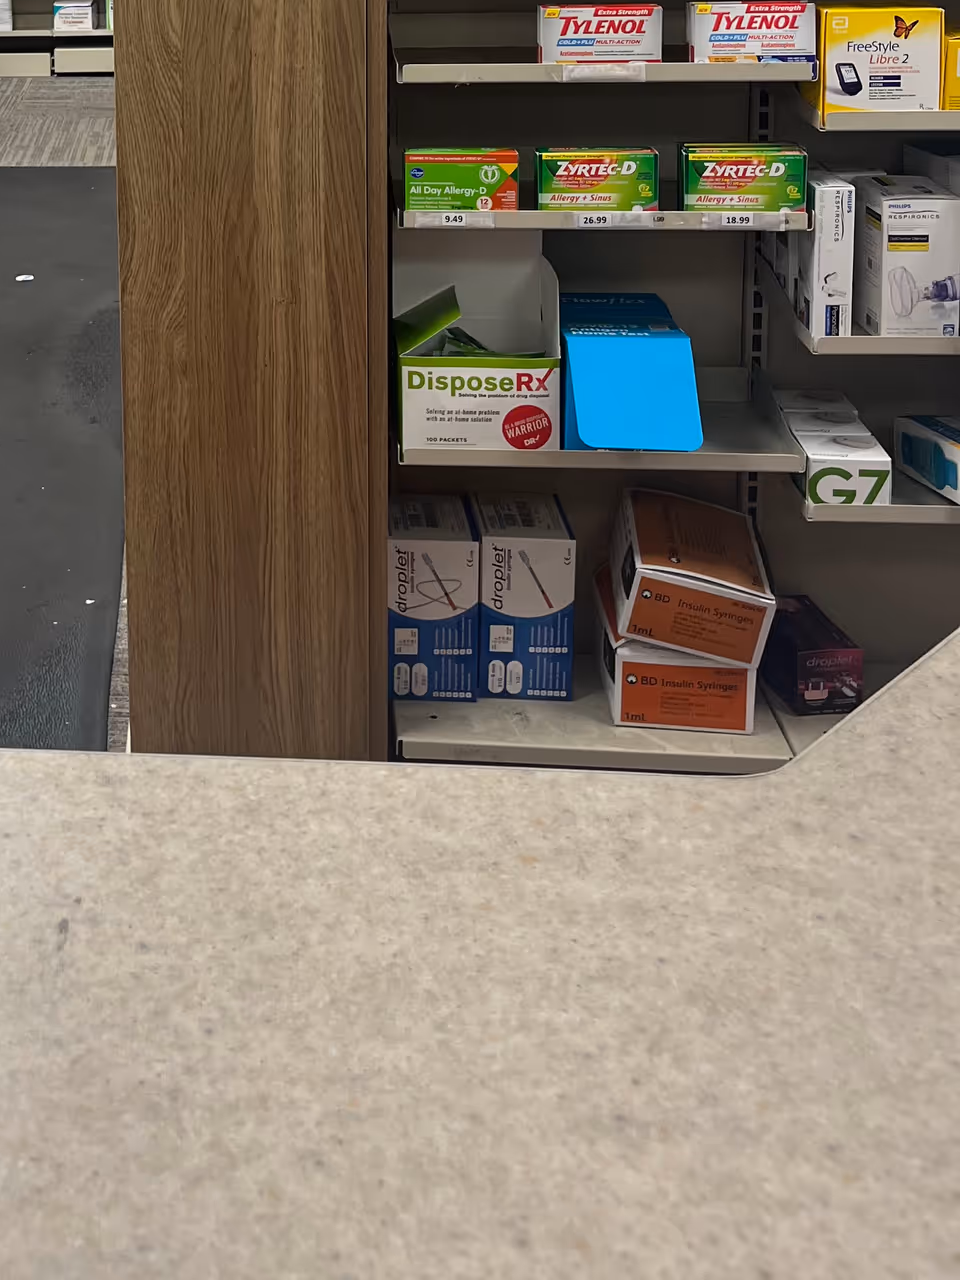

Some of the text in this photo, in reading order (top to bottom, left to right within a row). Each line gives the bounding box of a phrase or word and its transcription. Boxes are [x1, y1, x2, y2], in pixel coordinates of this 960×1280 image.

[559, 16, 646, 36] TYLENOL
[711, 12, 799, 32] TYLENOL
[847, 41, 900, 53] FreeStyle
[870, 54, 909, 64] Libre 2
[556, 161, 637, 177] ZYRTEC-D
[702, 163, 785, 178] ZYRTEC-D
[424, 187, 442, 196] Day
[444, 186, 486, 196] Allergy-D
[550, 195, 580, 203] Allergy
[696, 196, 727, 204] Allergy
[408, 368, 554, 397] DisposeRx
[506, 418, 550, 439] WARRIOR
[808, 466, 890, 504] G7
[395, 549, 409, 612] droplet
[491, 546, 505, 610] droplet
[654, 593, 754, 625] BD Insulin Syringes
[631, 624, 655, 637] 1mL
[641, 676, 738, 692] BD Insulin Syringes
[624, 712, 646, 721] 1mL
